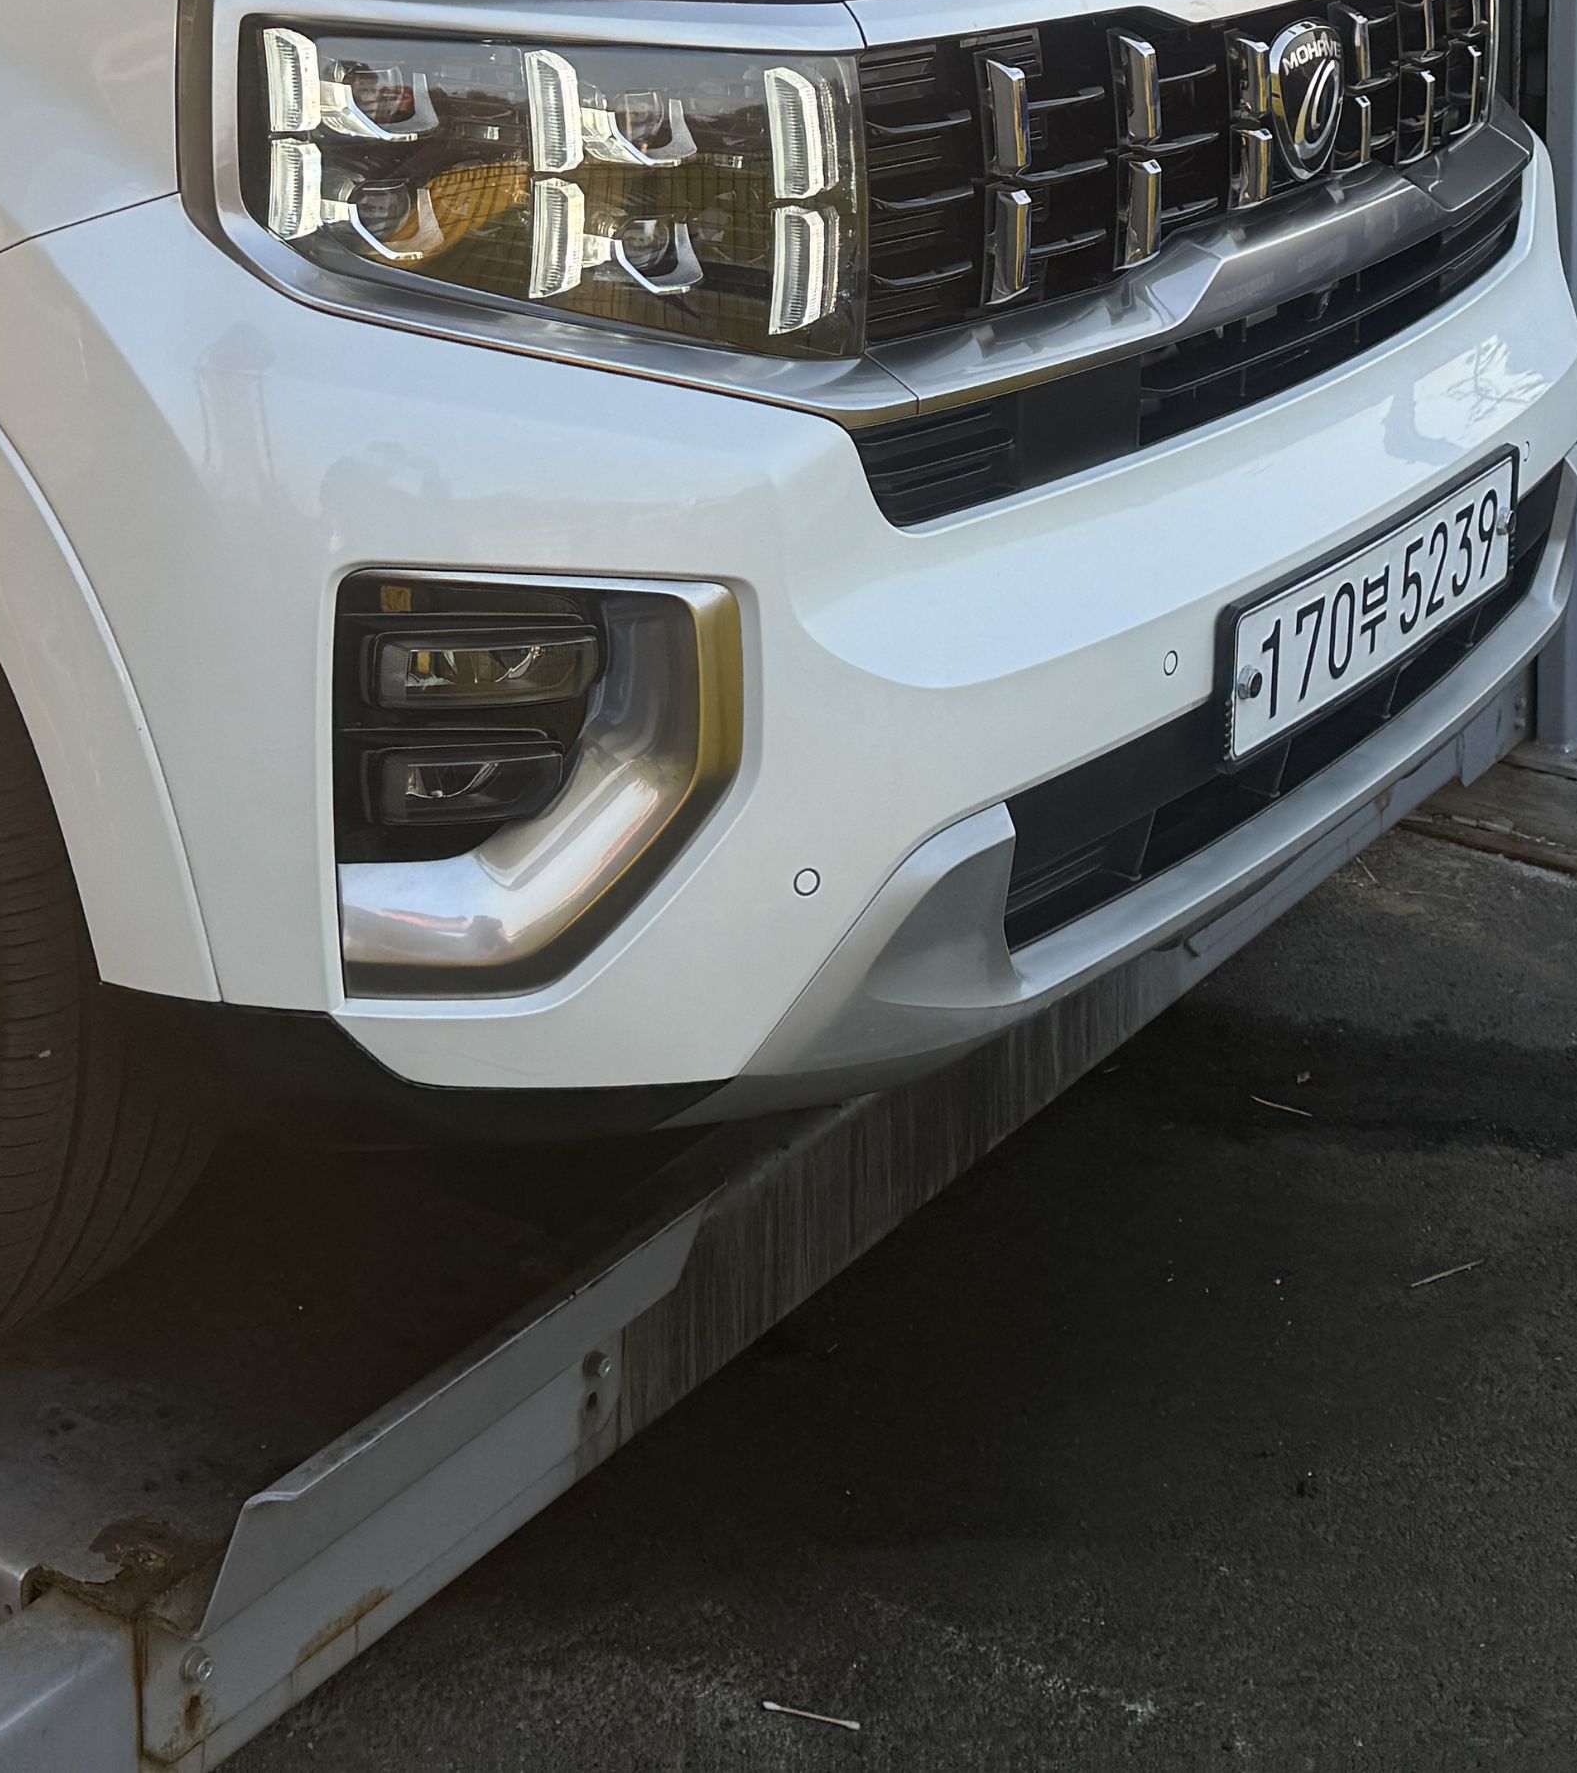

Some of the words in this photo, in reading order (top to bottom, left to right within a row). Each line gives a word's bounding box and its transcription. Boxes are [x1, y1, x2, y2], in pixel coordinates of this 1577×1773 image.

[1282, 38, 1343, 76] MOHAVE
[1260, 564, 1390, 721] 170부
[1398, 488, 1499, 636] 5239
